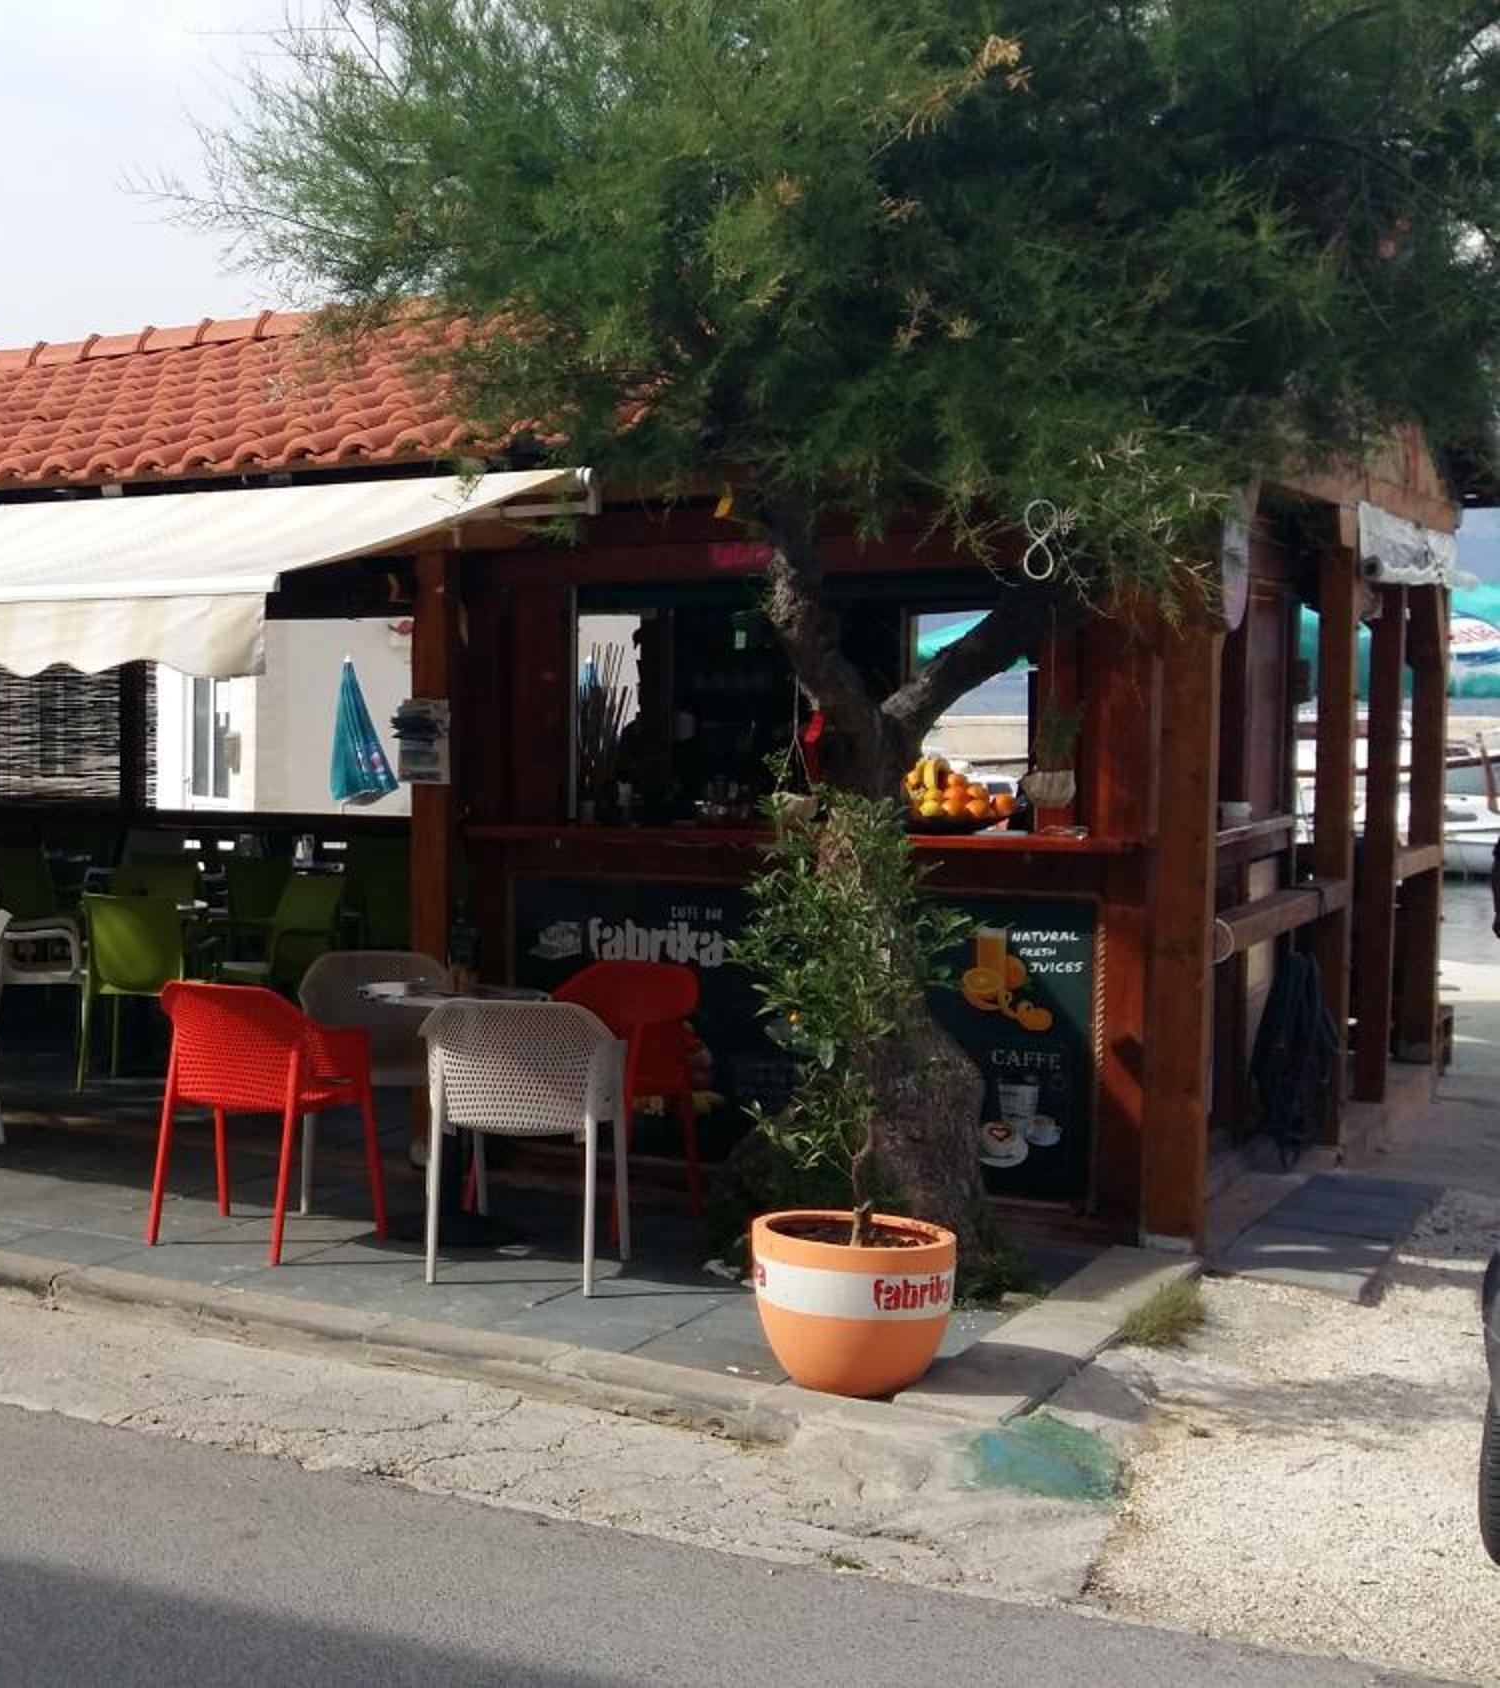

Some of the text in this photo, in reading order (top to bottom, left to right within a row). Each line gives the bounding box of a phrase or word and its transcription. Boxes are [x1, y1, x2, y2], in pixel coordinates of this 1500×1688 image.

[587, 916, 725, 967] fabrika
[1011, 931, 1080, 943] NATURAL
[1019, 947, 1057, 957] FRESH
[1029, 961, 1085, 973] JUICES
[991, 1050, 1061, 1070] CAFFE
